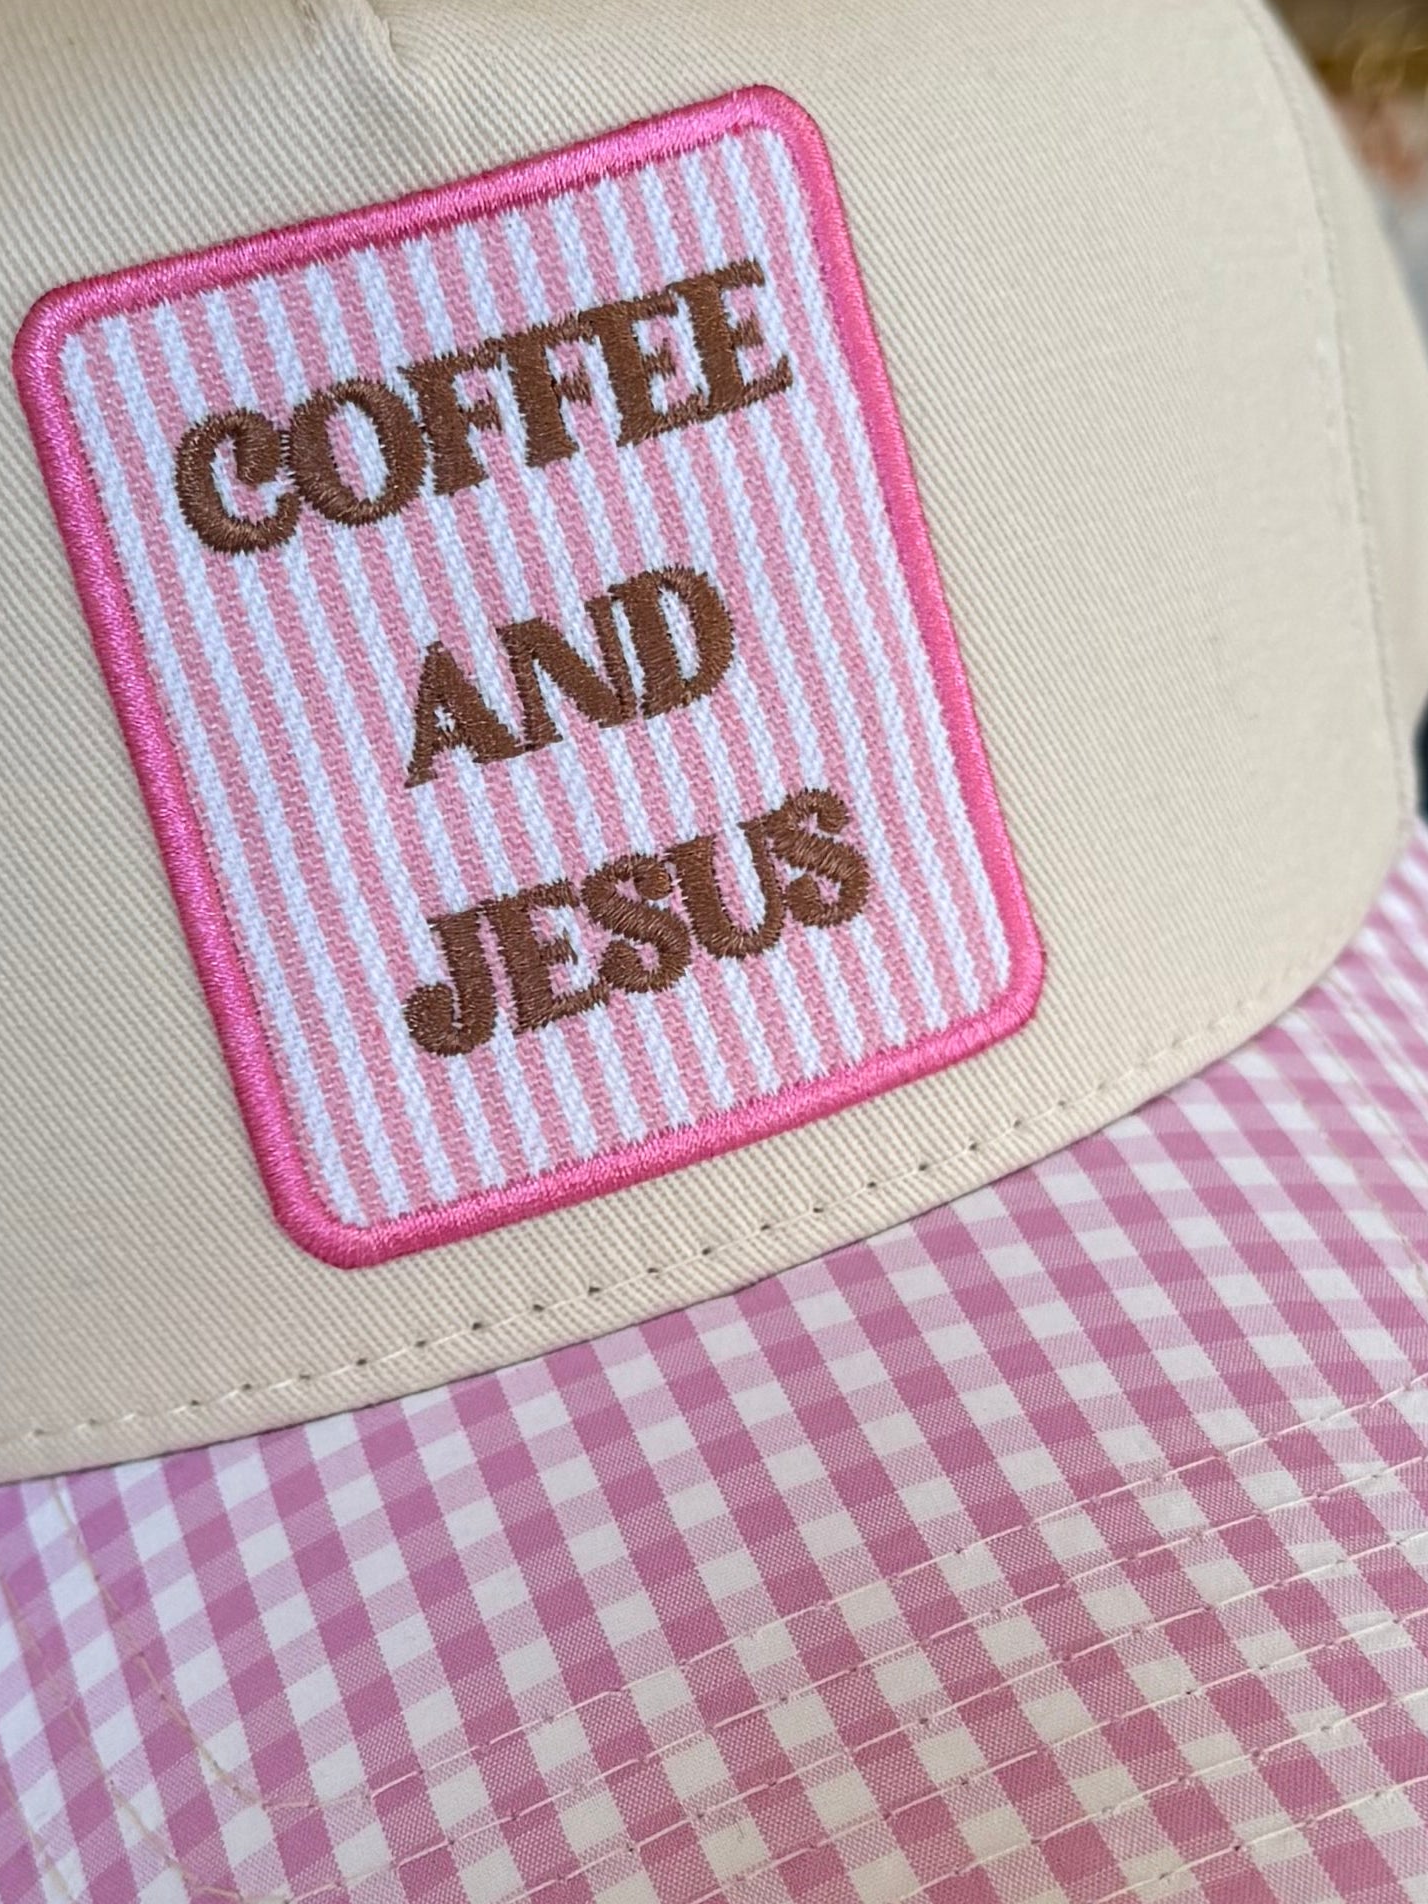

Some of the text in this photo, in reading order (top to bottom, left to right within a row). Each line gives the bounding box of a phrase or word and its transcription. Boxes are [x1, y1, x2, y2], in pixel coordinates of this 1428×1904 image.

[173, 257, 794, 556] COFFEE
[403, 565, 736, 789] AND
[401, 786, 870, 1058] JESUS
